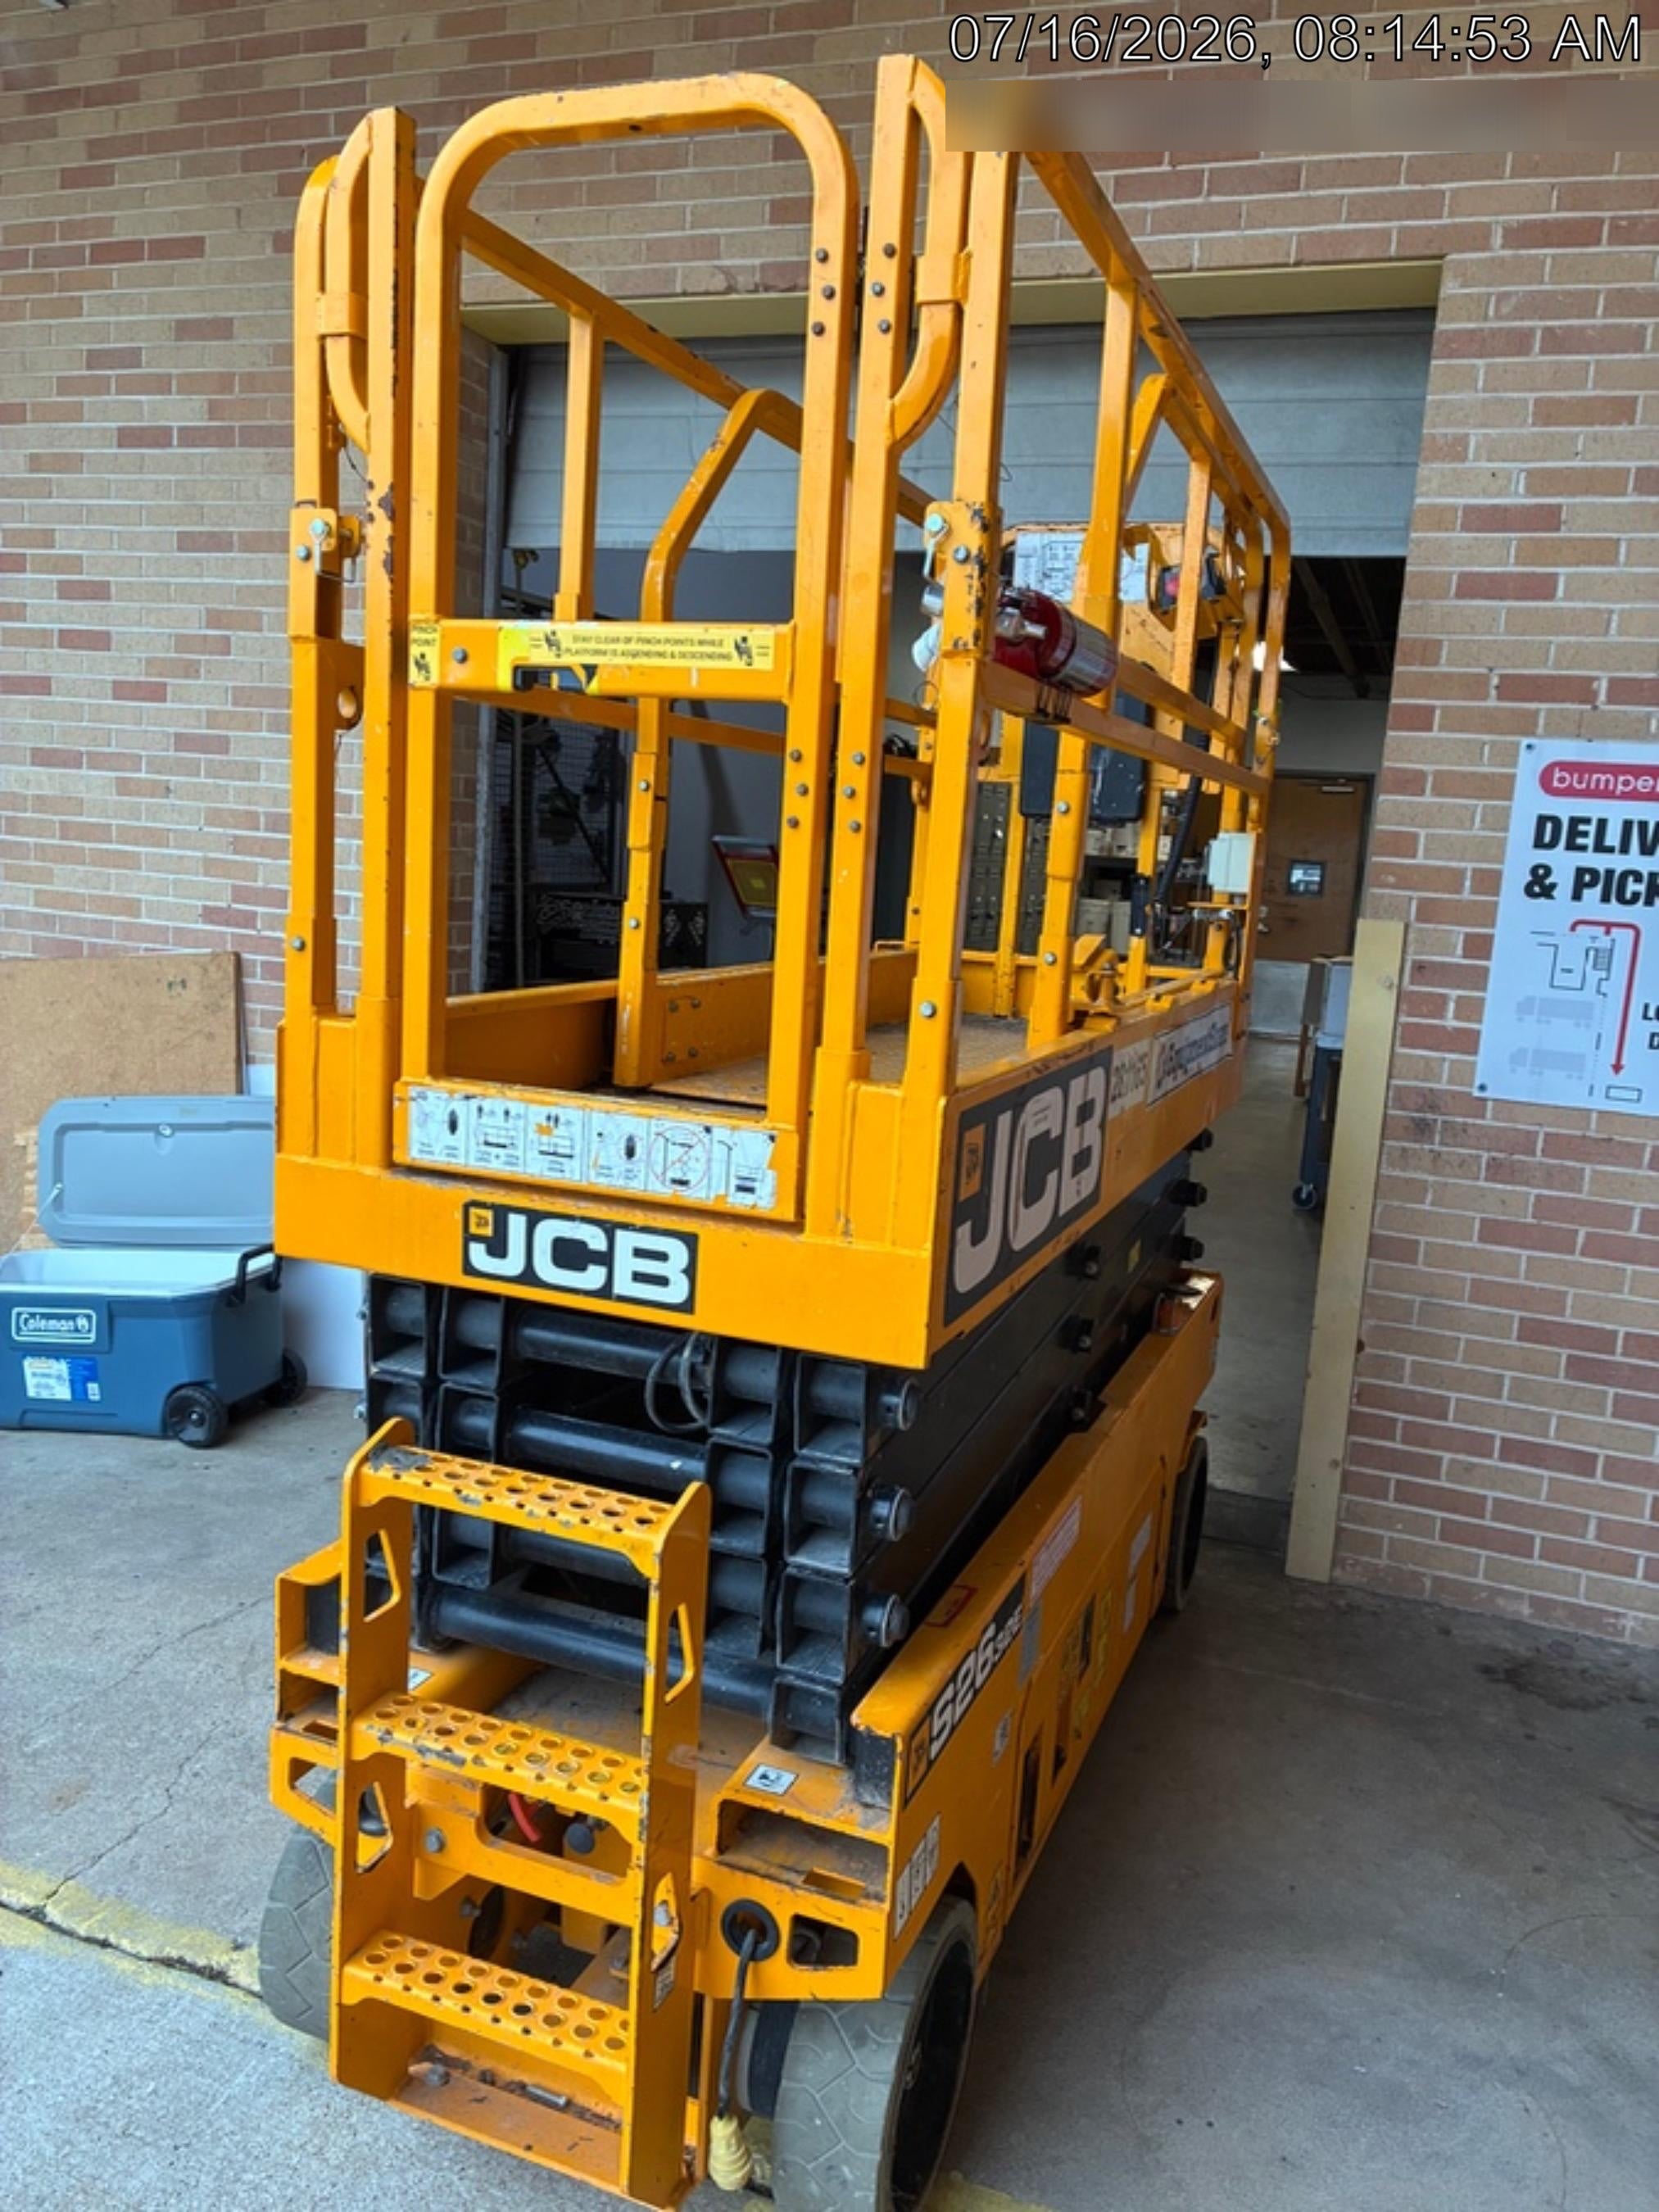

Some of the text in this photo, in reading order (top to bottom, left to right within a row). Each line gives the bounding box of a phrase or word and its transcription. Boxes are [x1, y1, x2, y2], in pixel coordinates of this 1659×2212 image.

[412, 637, 437, 647] POINT
[1524, 863, 1558, 900] &
[953, 1066, 1106, 1294] JCB
[469, 1213, 690, 1305] JCB
[19, 1312, 75, 1332] Coleman
